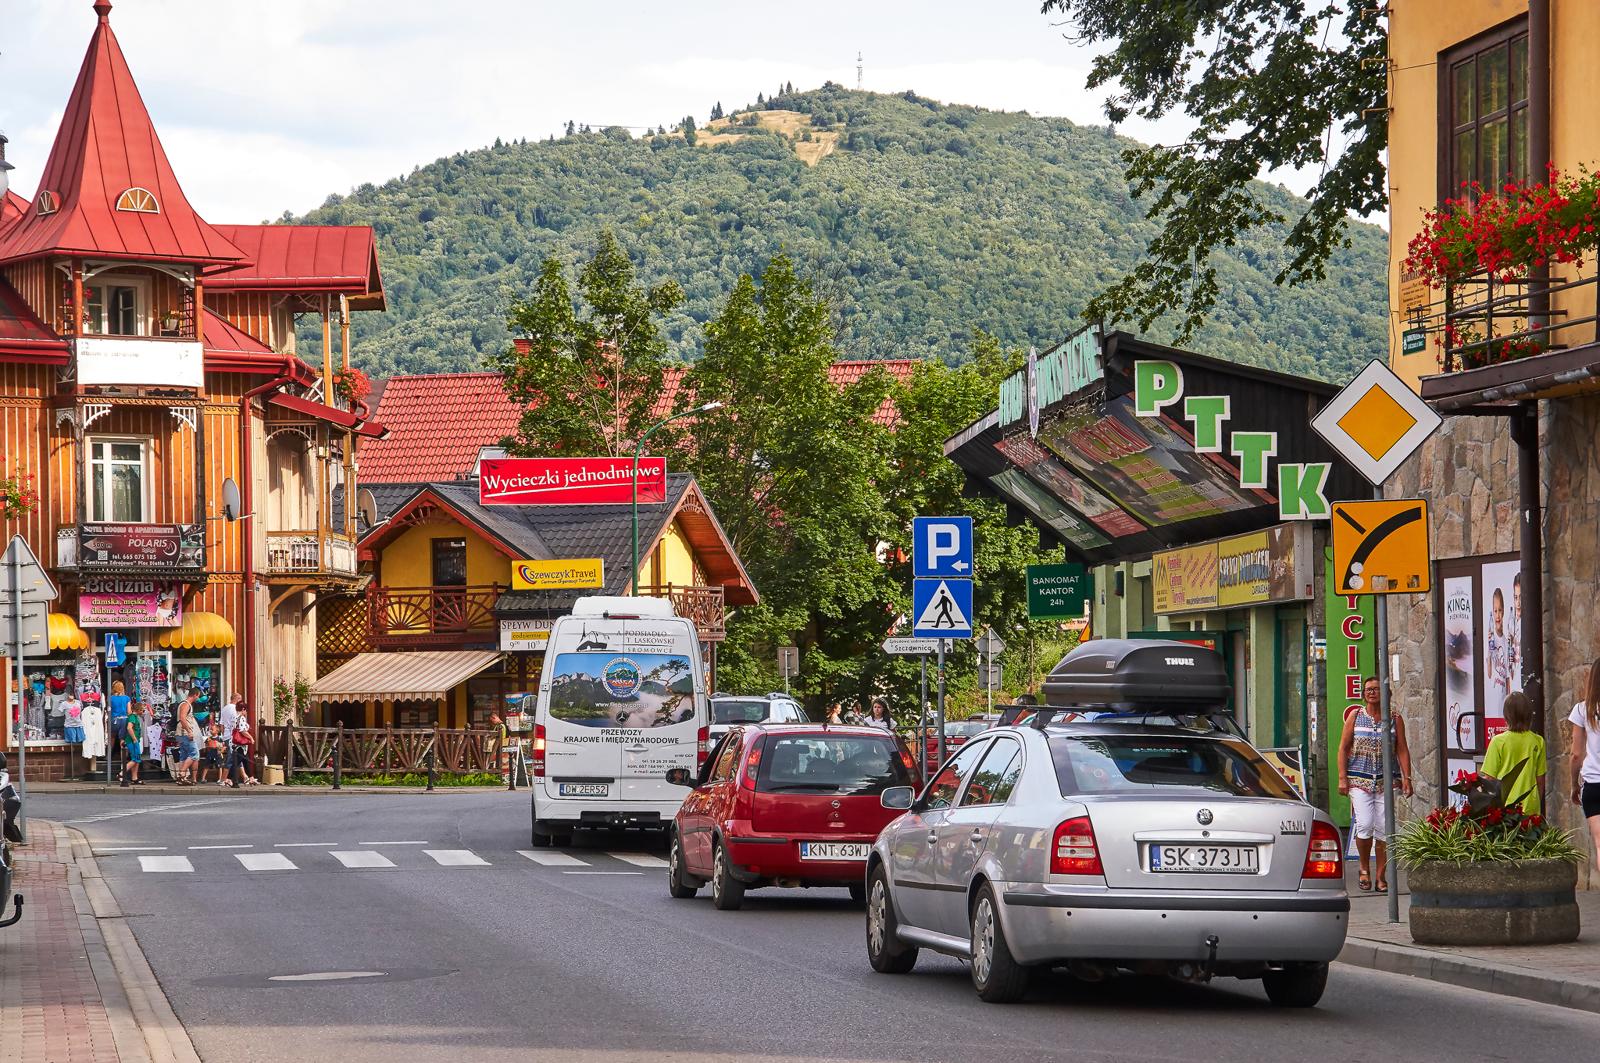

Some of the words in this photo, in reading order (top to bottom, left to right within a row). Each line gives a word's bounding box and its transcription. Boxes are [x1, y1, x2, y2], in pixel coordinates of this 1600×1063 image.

[1134, 360, 1333, 520] PTTK
[484, 468, 560, 493] Wycieczki
[563, 464, 661, 488] jednodniowe
[128, 538, 168, 548] POLARIS
[927, 524, 960, 570] P
[85, 579, 154, 593] Bielizna
[1032, 575, 1080, 585] BANKOMAT
[1039, 587, 1074, 596] KANTOR
[1050, 598, 1064, 606] 24h
[1447, 598, 1471, 614] KINGA
[1164, 657, 1195, 666] THULE
[605, 737, 680, 745] MIĘDZYNARODOWE
[580, 785, 606, 794] 2ER52
[809, 843, 836, 857] KNT
[840, 844, 869, 857] 63WJ
[1163, 847, 1191, 867] SK
[1196, 848, 1254, 867] 373JT
